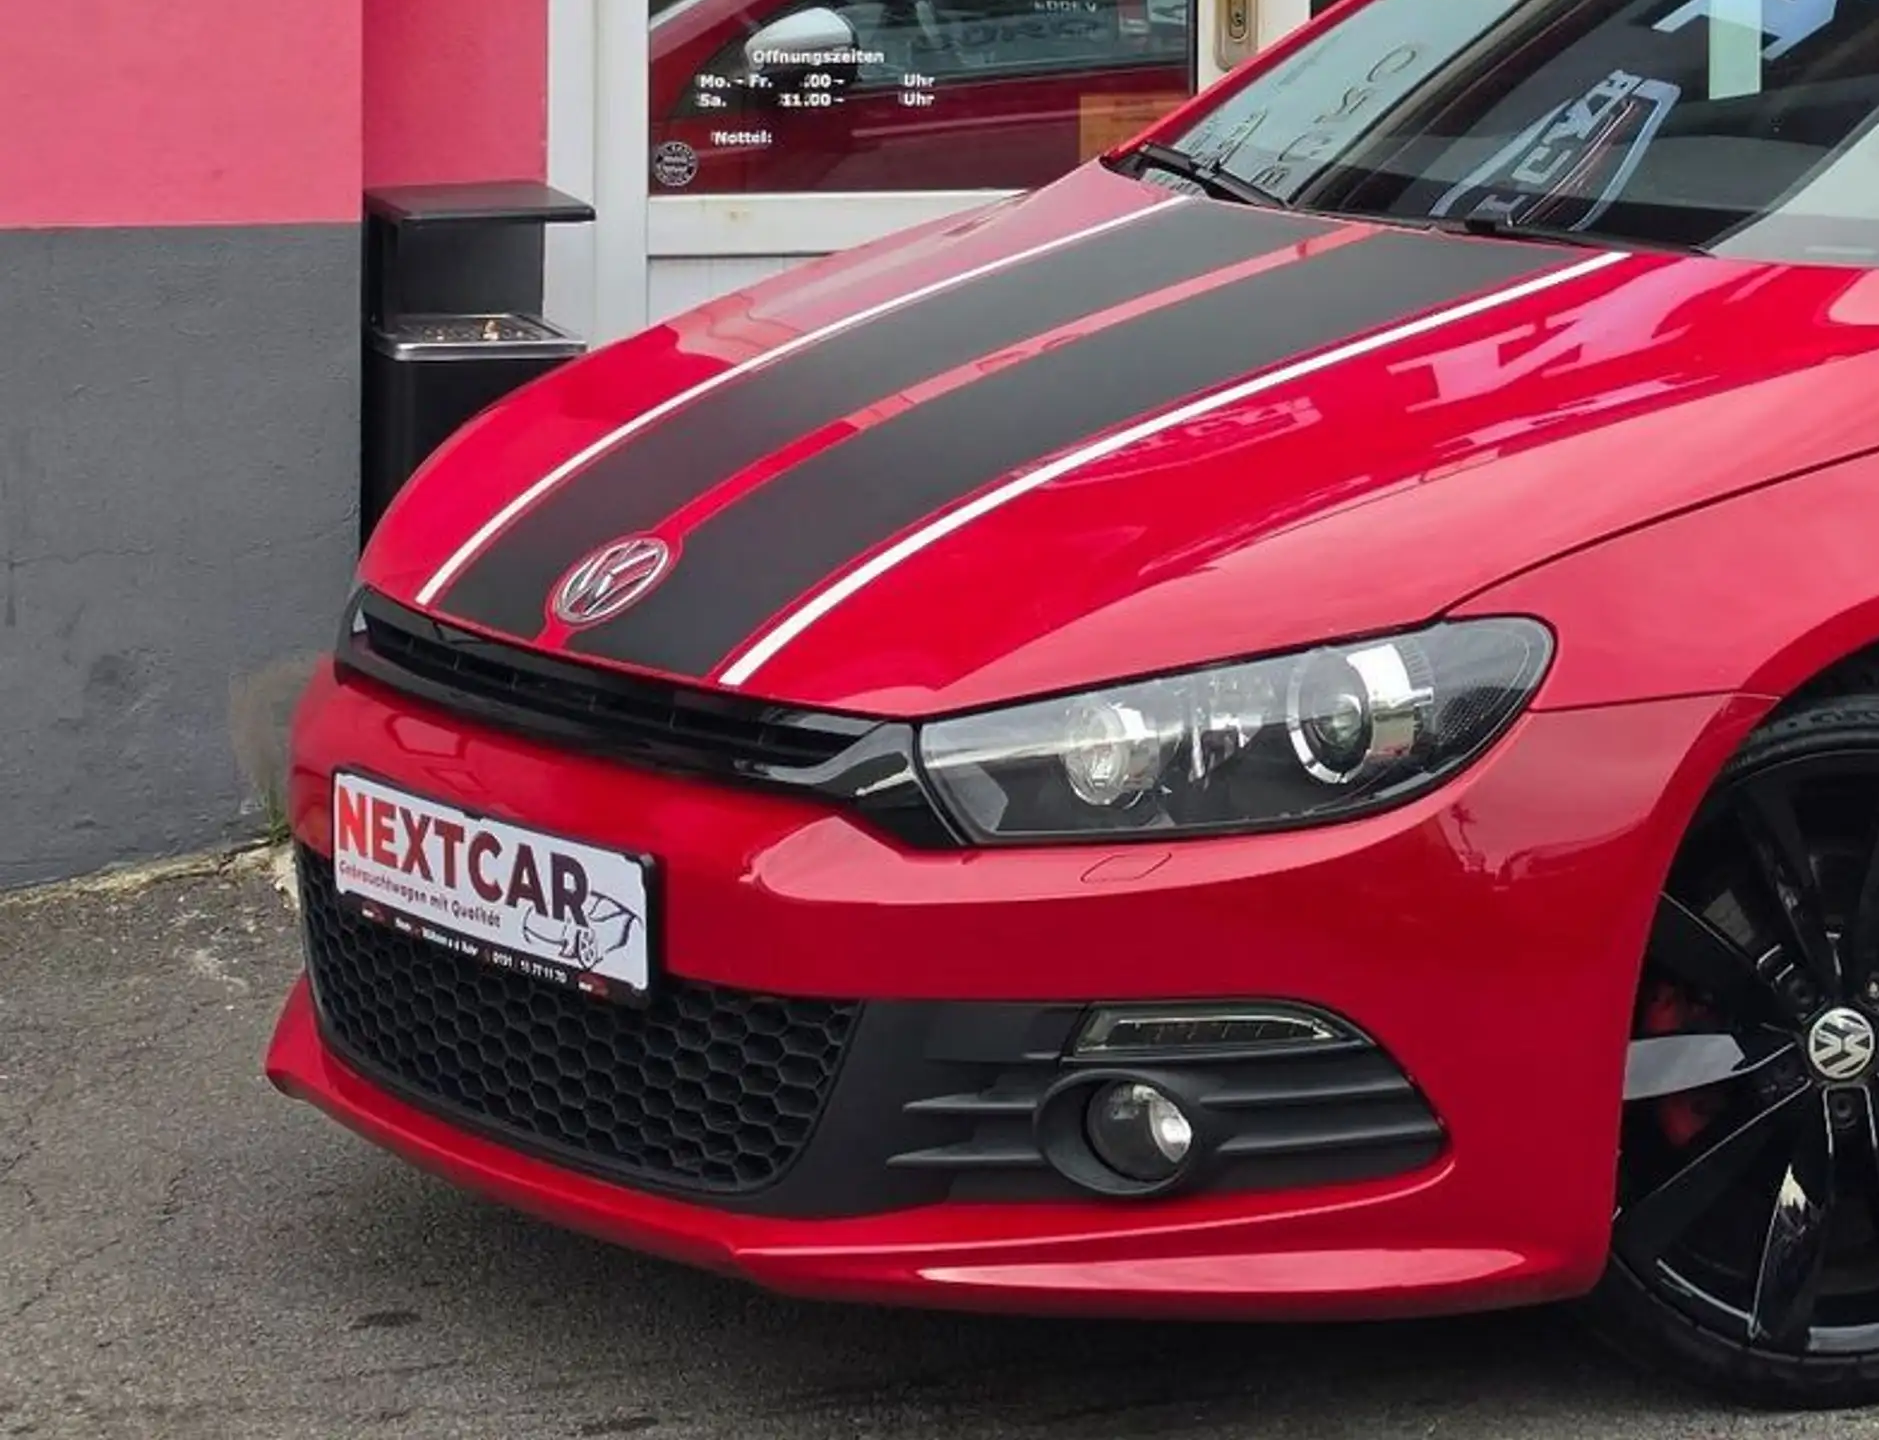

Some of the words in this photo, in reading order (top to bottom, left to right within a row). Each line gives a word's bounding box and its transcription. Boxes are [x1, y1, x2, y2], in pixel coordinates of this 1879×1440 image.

[903, 74, 935, 88] Uhr
[902, 93, 935, 107] Uhr
[338, 785, 590, 928] NEXTCAR
